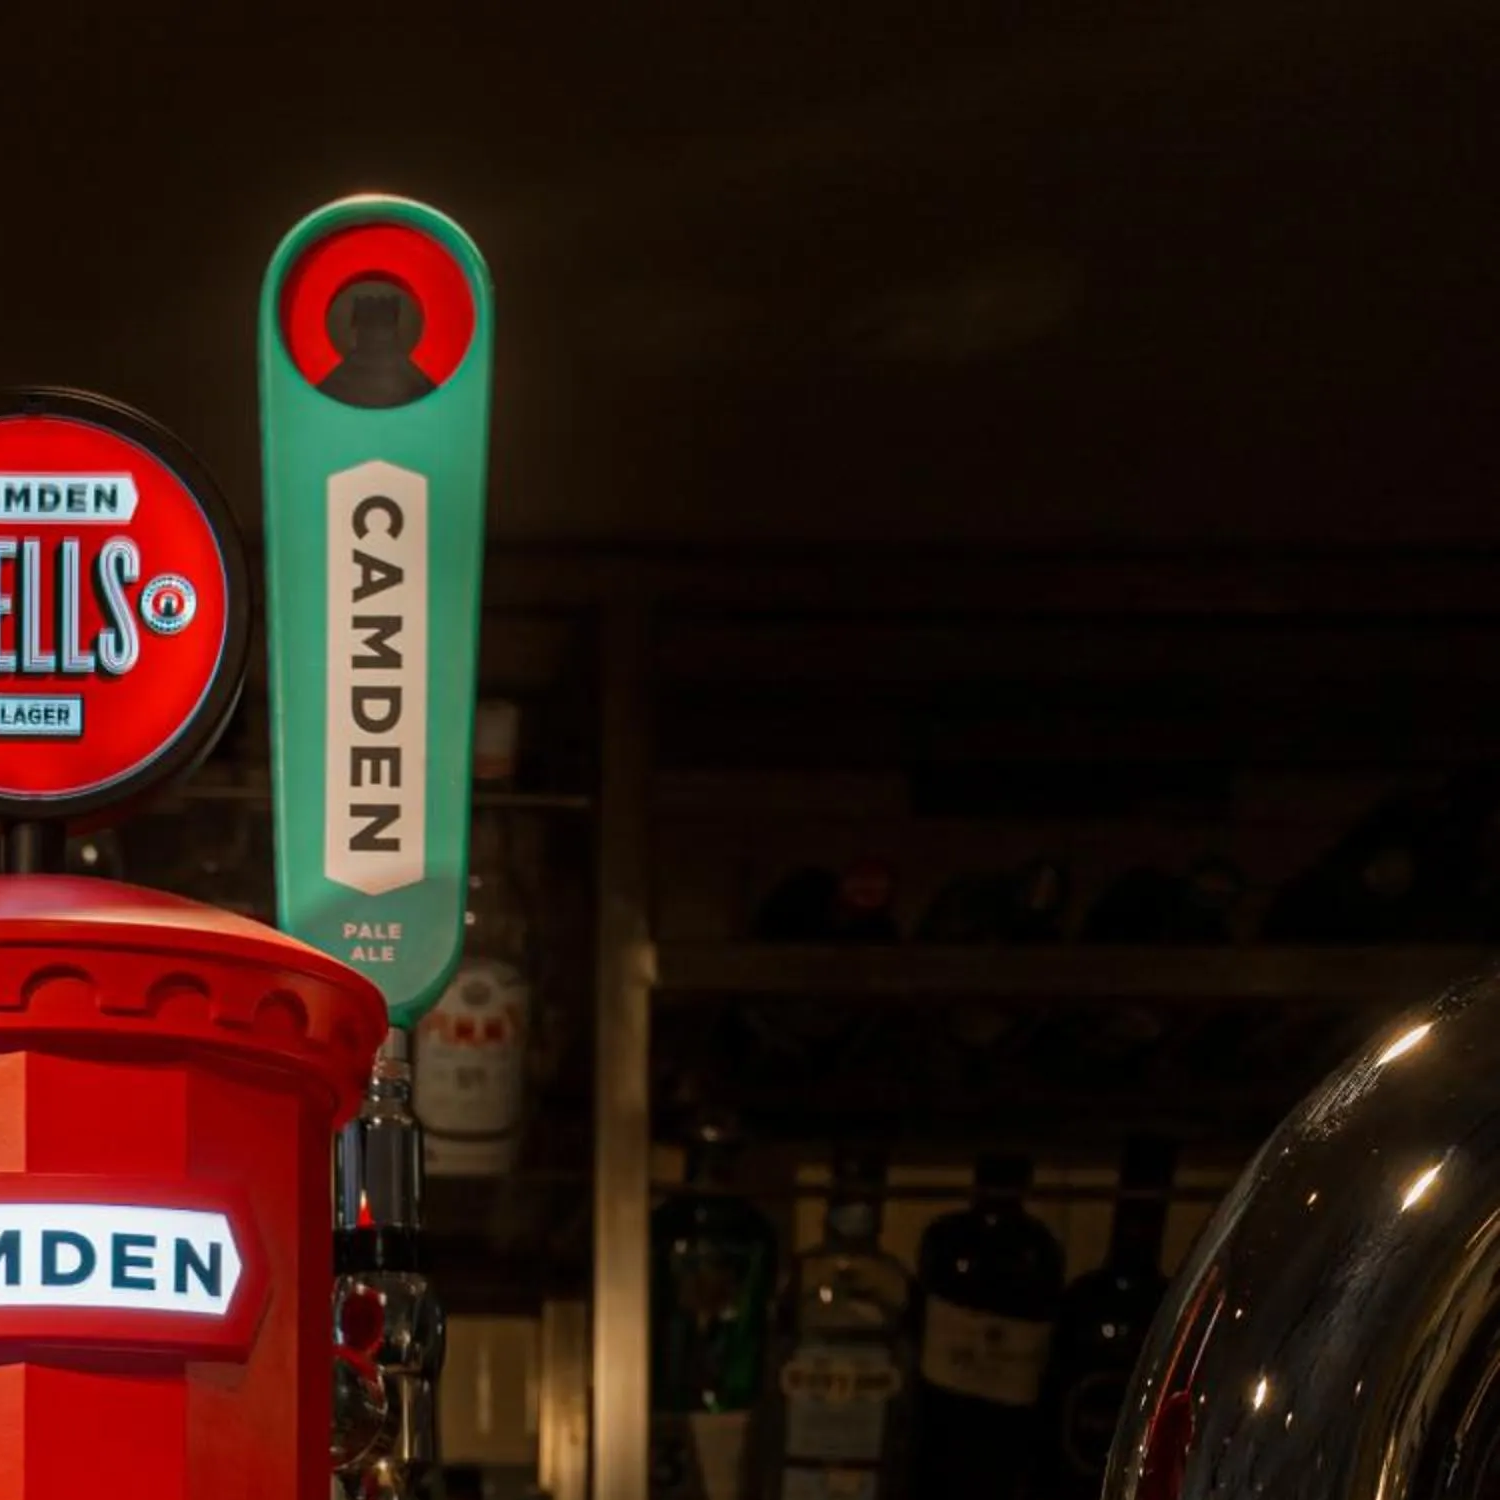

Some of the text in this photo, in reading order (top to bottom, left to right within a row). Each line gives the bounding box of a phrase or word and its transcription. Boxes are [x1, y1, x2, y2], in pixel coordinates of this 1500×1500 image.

[349, 494, 405, 852] CAMDEN
[0, 703, 70, 726] LAGER
[342, 922, 403, 940] PALE
[351, 945, 396, 962] ALE
